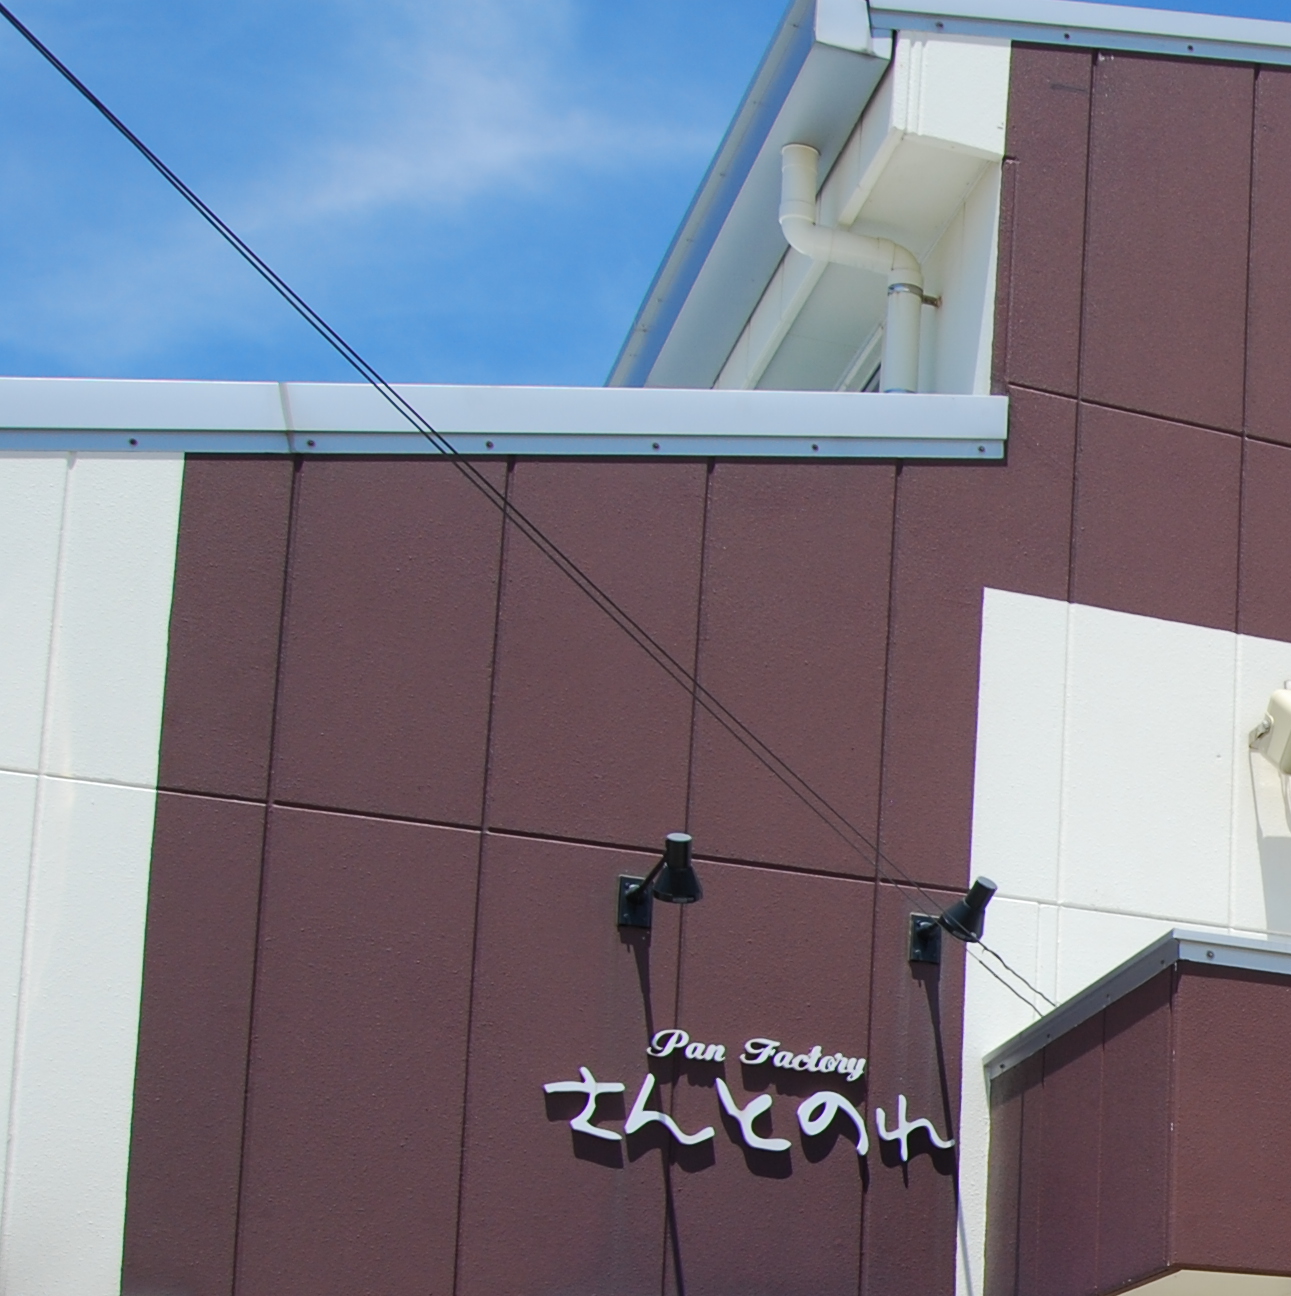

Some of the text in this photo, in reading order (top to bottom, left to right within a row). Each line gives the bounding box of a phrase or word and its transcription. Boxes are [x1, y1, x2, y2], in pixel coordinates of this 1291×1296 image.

[646, 1029, 866, 1082] Pan Factory
[543, 1066, 955, 1162] さんとのれ
